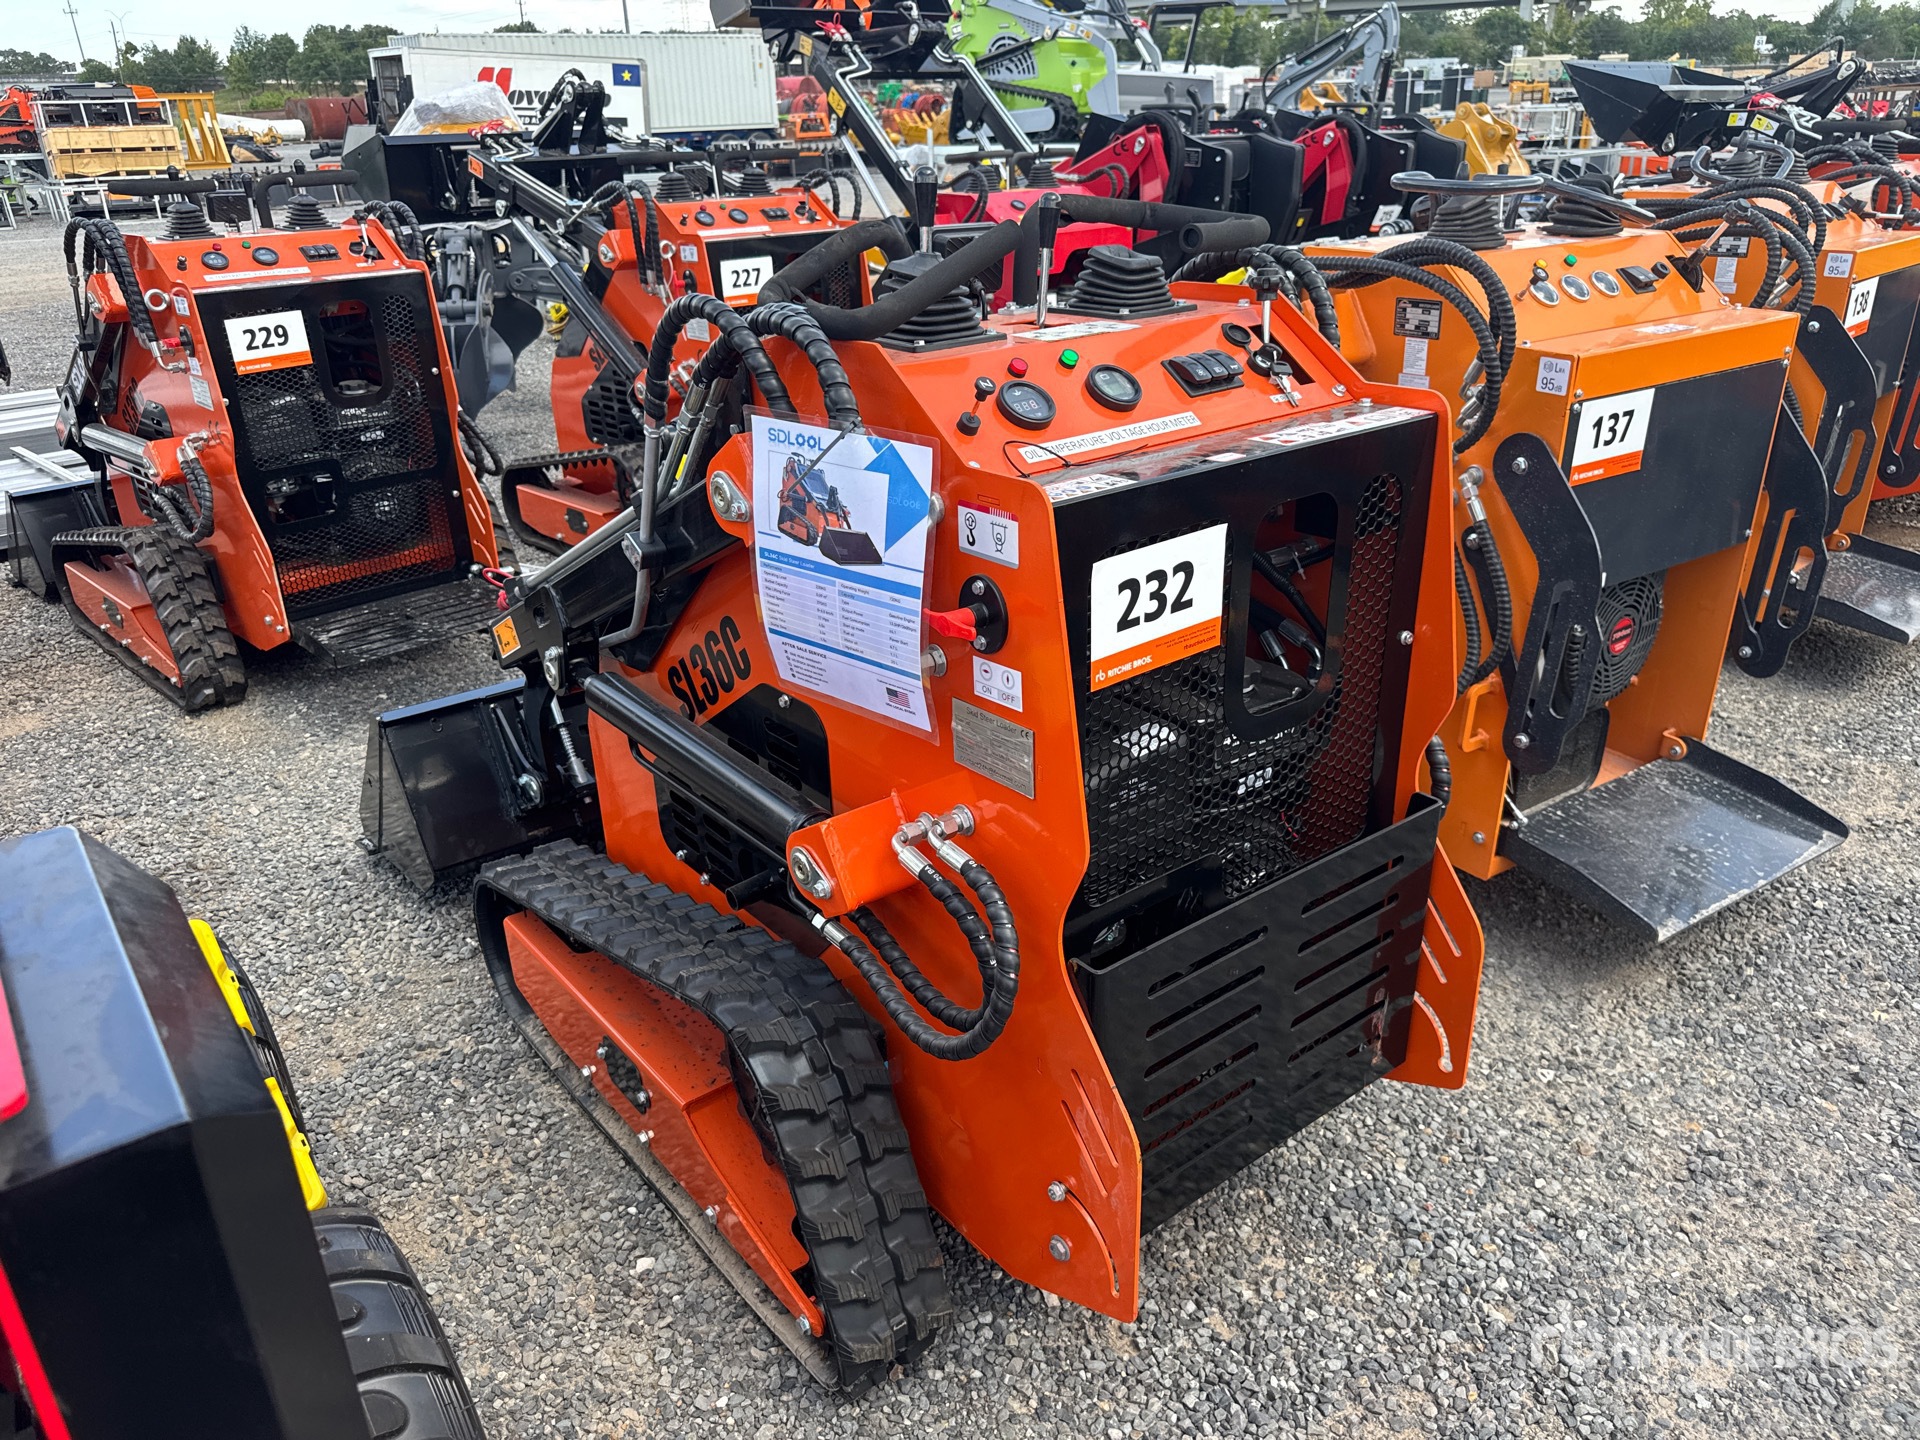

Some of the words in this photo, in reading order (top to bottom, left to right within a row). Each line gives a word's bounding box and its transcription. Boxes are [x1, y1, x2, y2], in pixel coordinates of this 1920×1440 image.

[731, 267, 761, 289] 227
[1852, 290, 1870, 317] 138
[242, 324, 289, 352] 229
[767, 427, 825, 451] SDLOOL
[1024, 449, 1042, 460] OIL
[1043, 435, 1105, 456] TEMPERATURE
[1148, 420, 1172, 433] HOUR
[1172, 415, 1198, 429] METER
[1592, 409, 1635, 449] 137
[764, 551, 779, 560] SL36C
[800, 561, 815, 569] Loader
[1116, 560, 1194, 633] 232
[781, 641, 796, 649] AFTER
[808, 649, 827, 659] SERVICE
[1183, 635, 1216, 650] rbauction.com
[667, 615, 751, 722] SL36C
[1107, 661, 1133, 678] RITCHIE
[981, 685, 992, 695] ON
[1002, 693, 1016, 704] OFF
[967, 706, 978, 719] Skid
[979, 713, 996, 726] Steer
[996, 719, 1017, 734] Loader
[1020, 729, 1030, 740] CE
